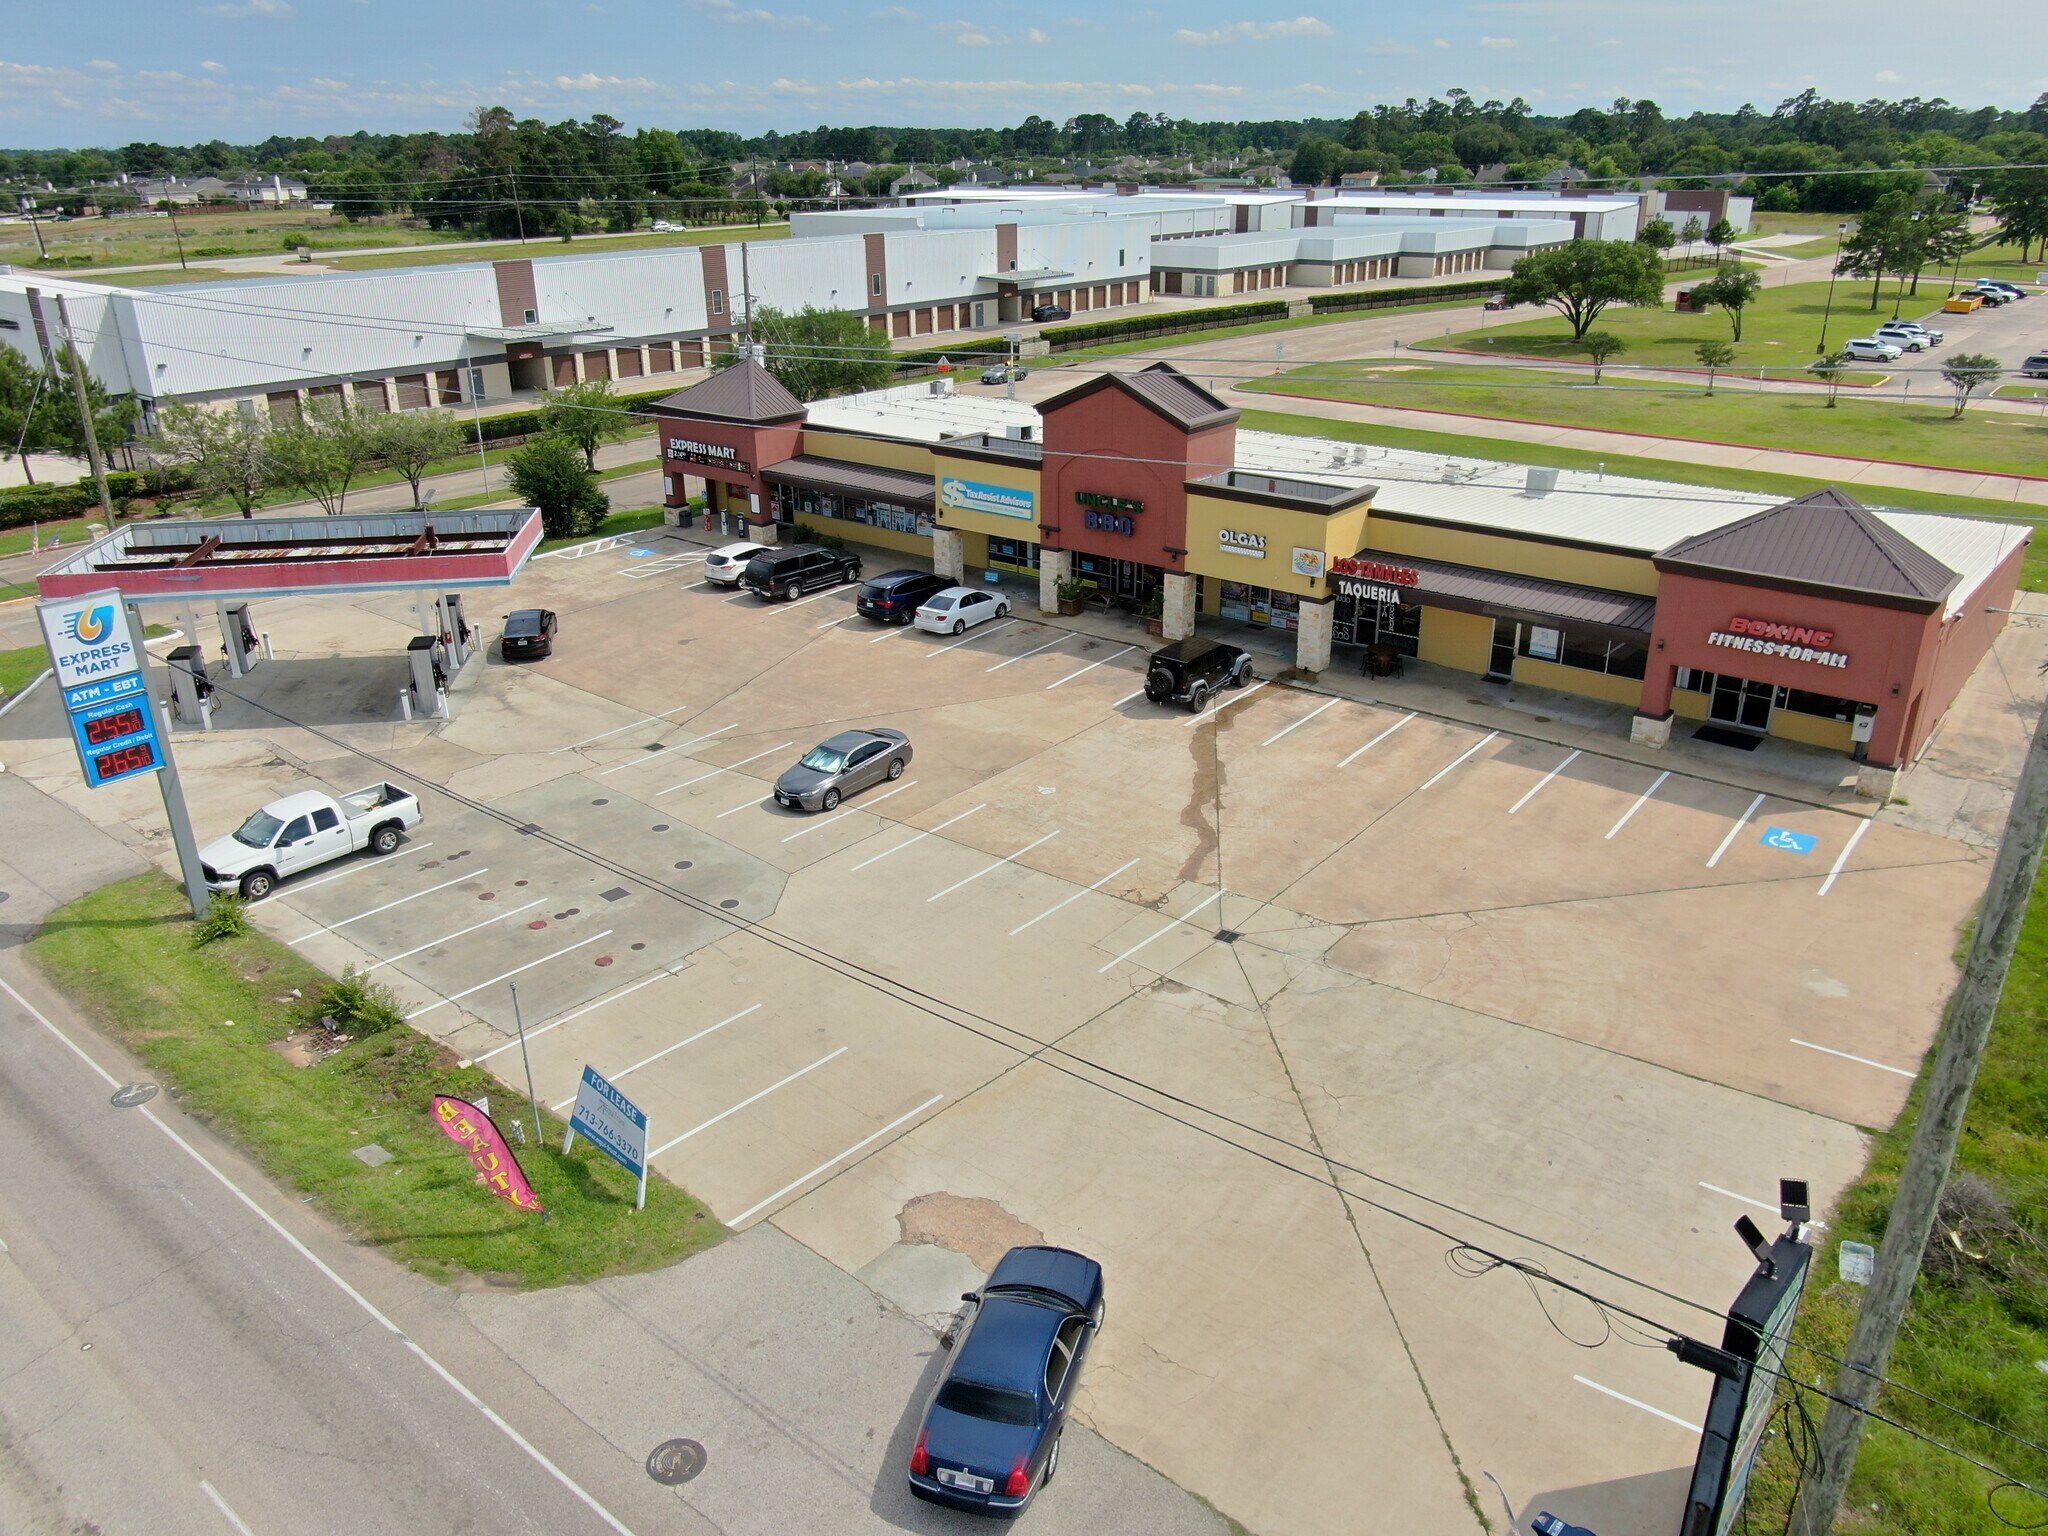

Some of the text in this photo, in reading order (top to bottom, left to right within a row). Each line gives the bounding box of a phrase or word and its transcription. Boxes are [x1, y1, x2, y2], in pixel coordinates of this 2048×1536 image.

[670, 438, 706, 454] EXPRESS
[707, 445, 735, 460] MART
[1219, 530, 1266, 548] OLGAS
[1333, 556, 1358, 575] LOS
[1360, 561, 1418, 586] TAMALES
[1339, 581, 1400, 604] TAQUERIA
[1729, 618, 1833, 647] BOXING
[59, 642, 131, 667] EXPRESS
[1708, 632, 1848, 668] FITNESS FOR ALL
[75, 657, 120, 676] MART
[72, 687, 101, 703] ATM
[113, 677, 138, 692] EBT
[88, 703, 134, 718] Regular Cash
[87, 746, 111, 756] Regular
[113, 738, 132, 749] Credit
[136, 733, 153, 741] Debit
[591, 1074, 609, 1097] FOR
[610, 1090, 637, 1122] LEASE
[579, 1105, 638, 1160] 713-766-3370
